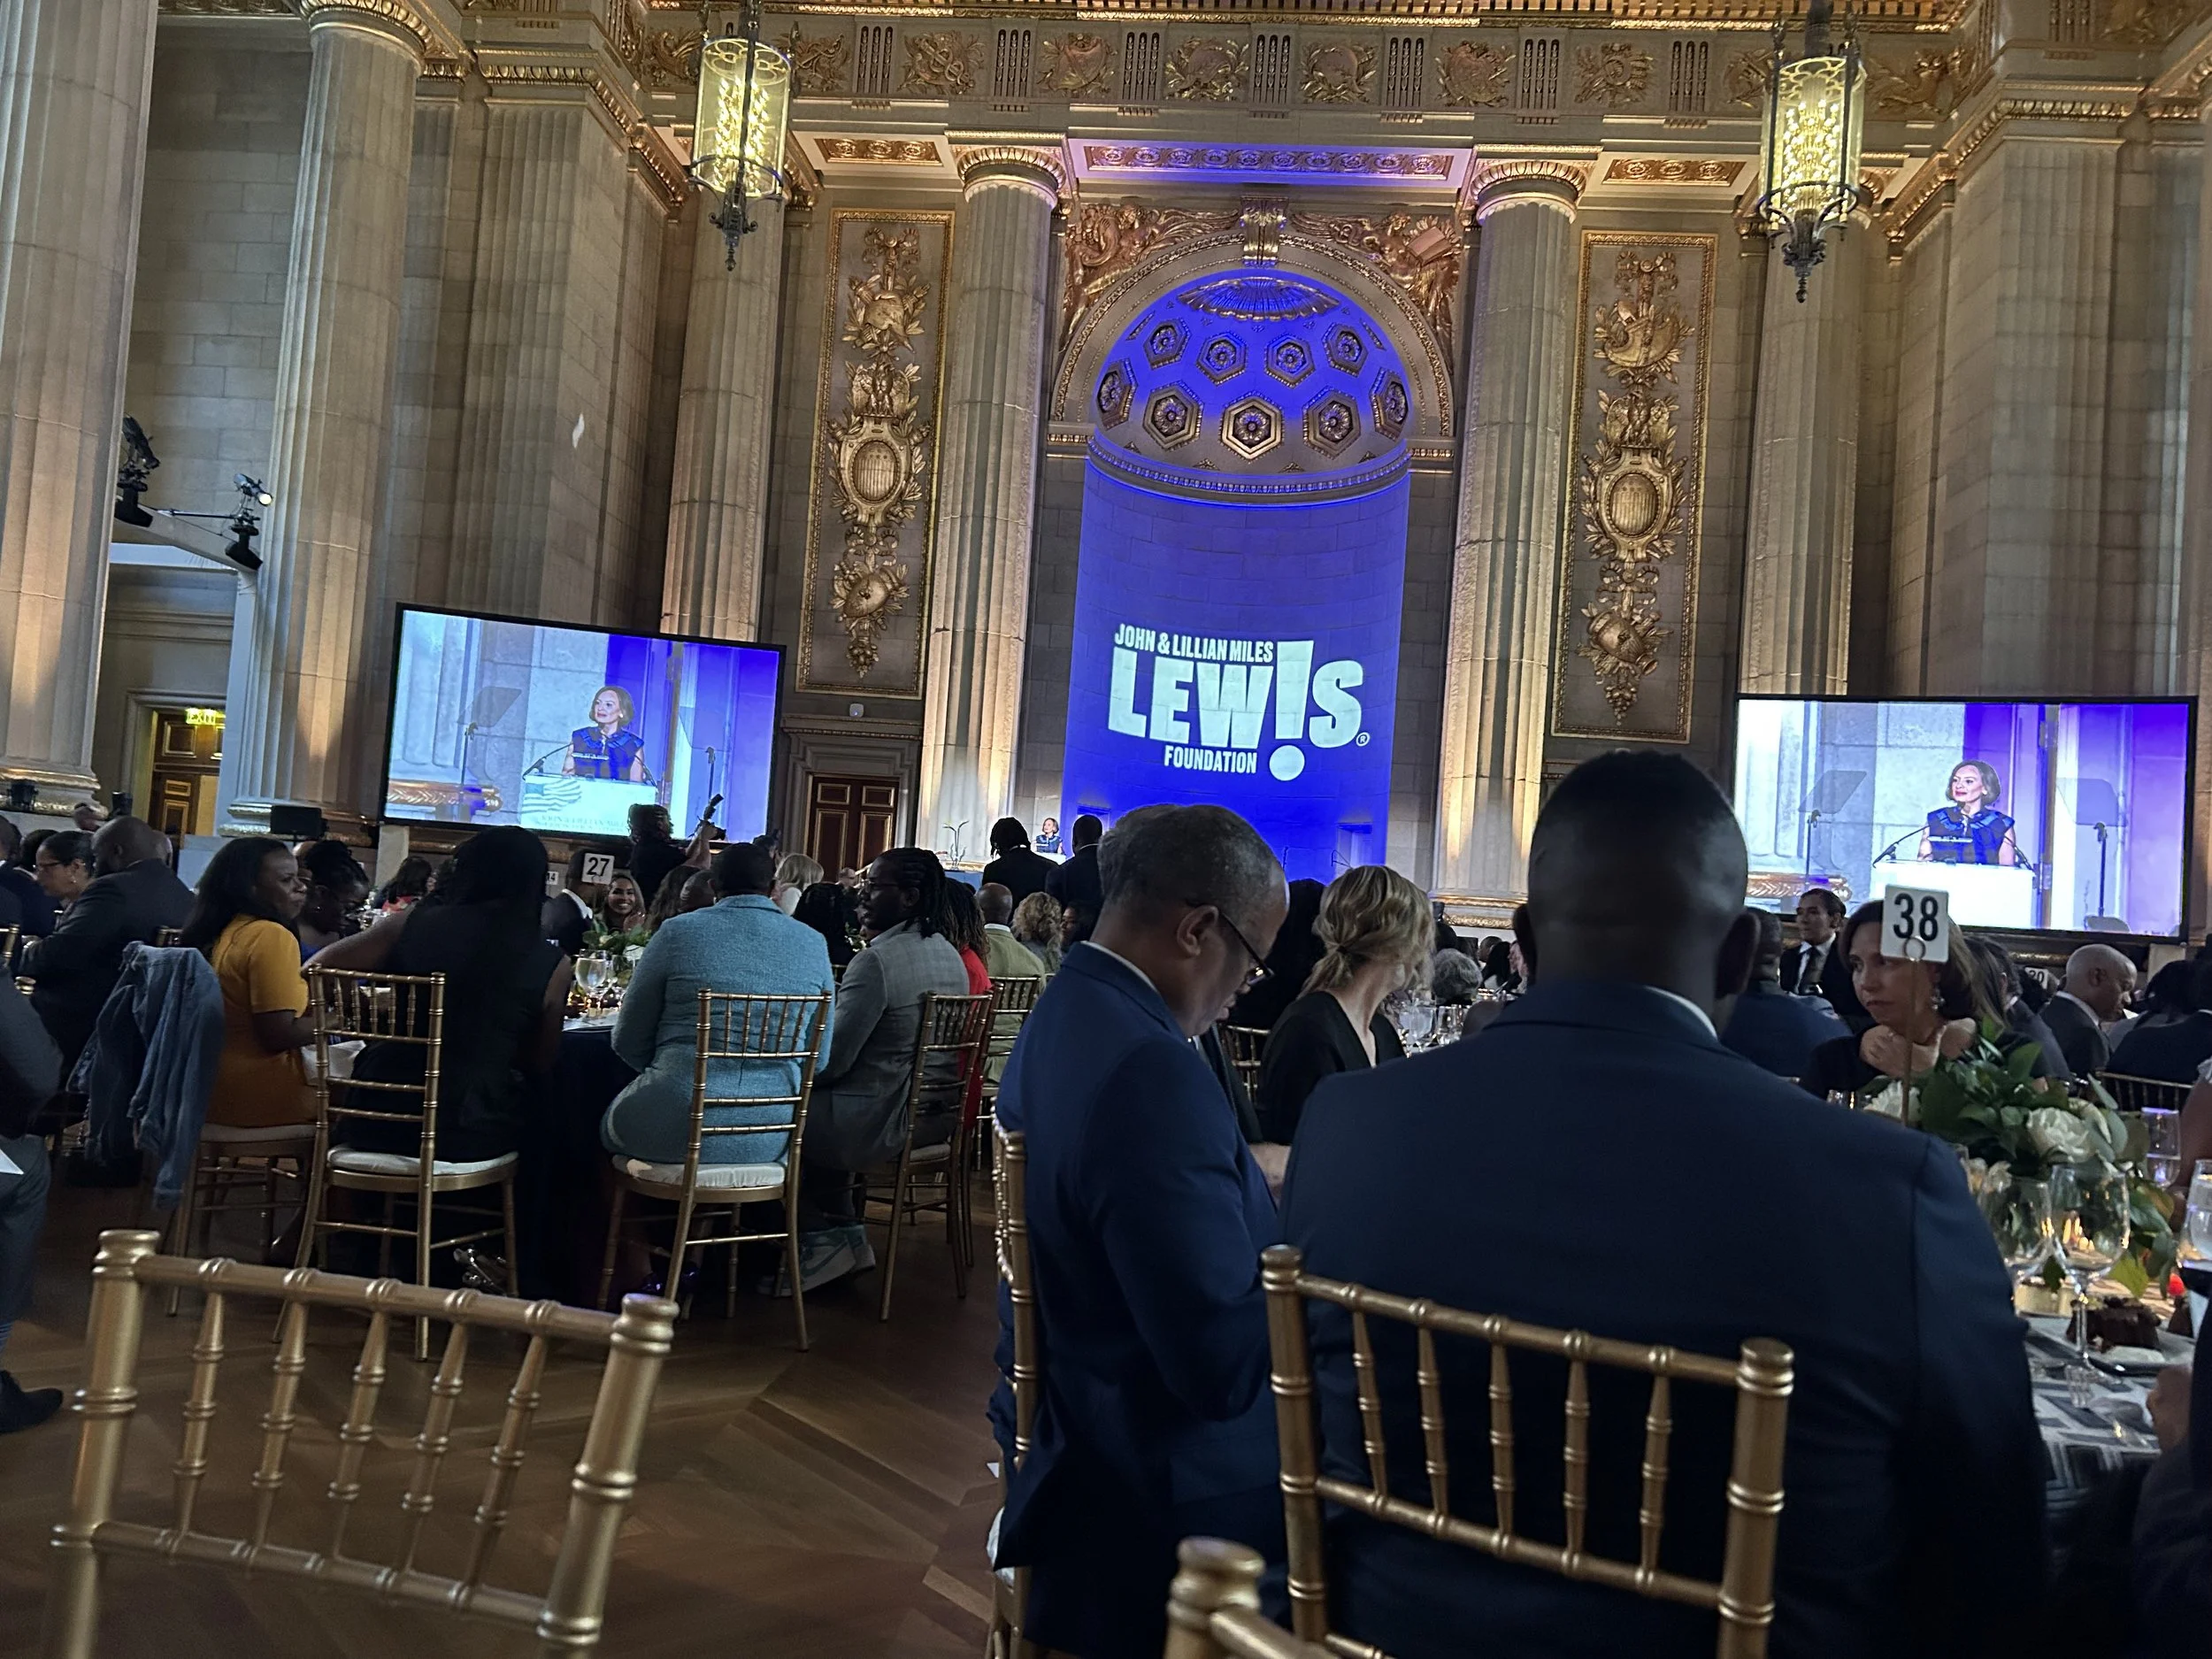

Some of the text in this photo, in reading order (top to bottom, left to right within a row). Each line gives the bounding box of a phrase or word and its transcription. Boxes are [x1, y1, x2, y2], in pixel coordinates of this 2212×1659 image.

[1114, 623, 1274, 663] JOHN & LILLIAN MILES
[1164, 745, 1257, 774] FOUNDATION
[587, 856, 611, 877] 27
[1893, 893, 1939, 941] 38
